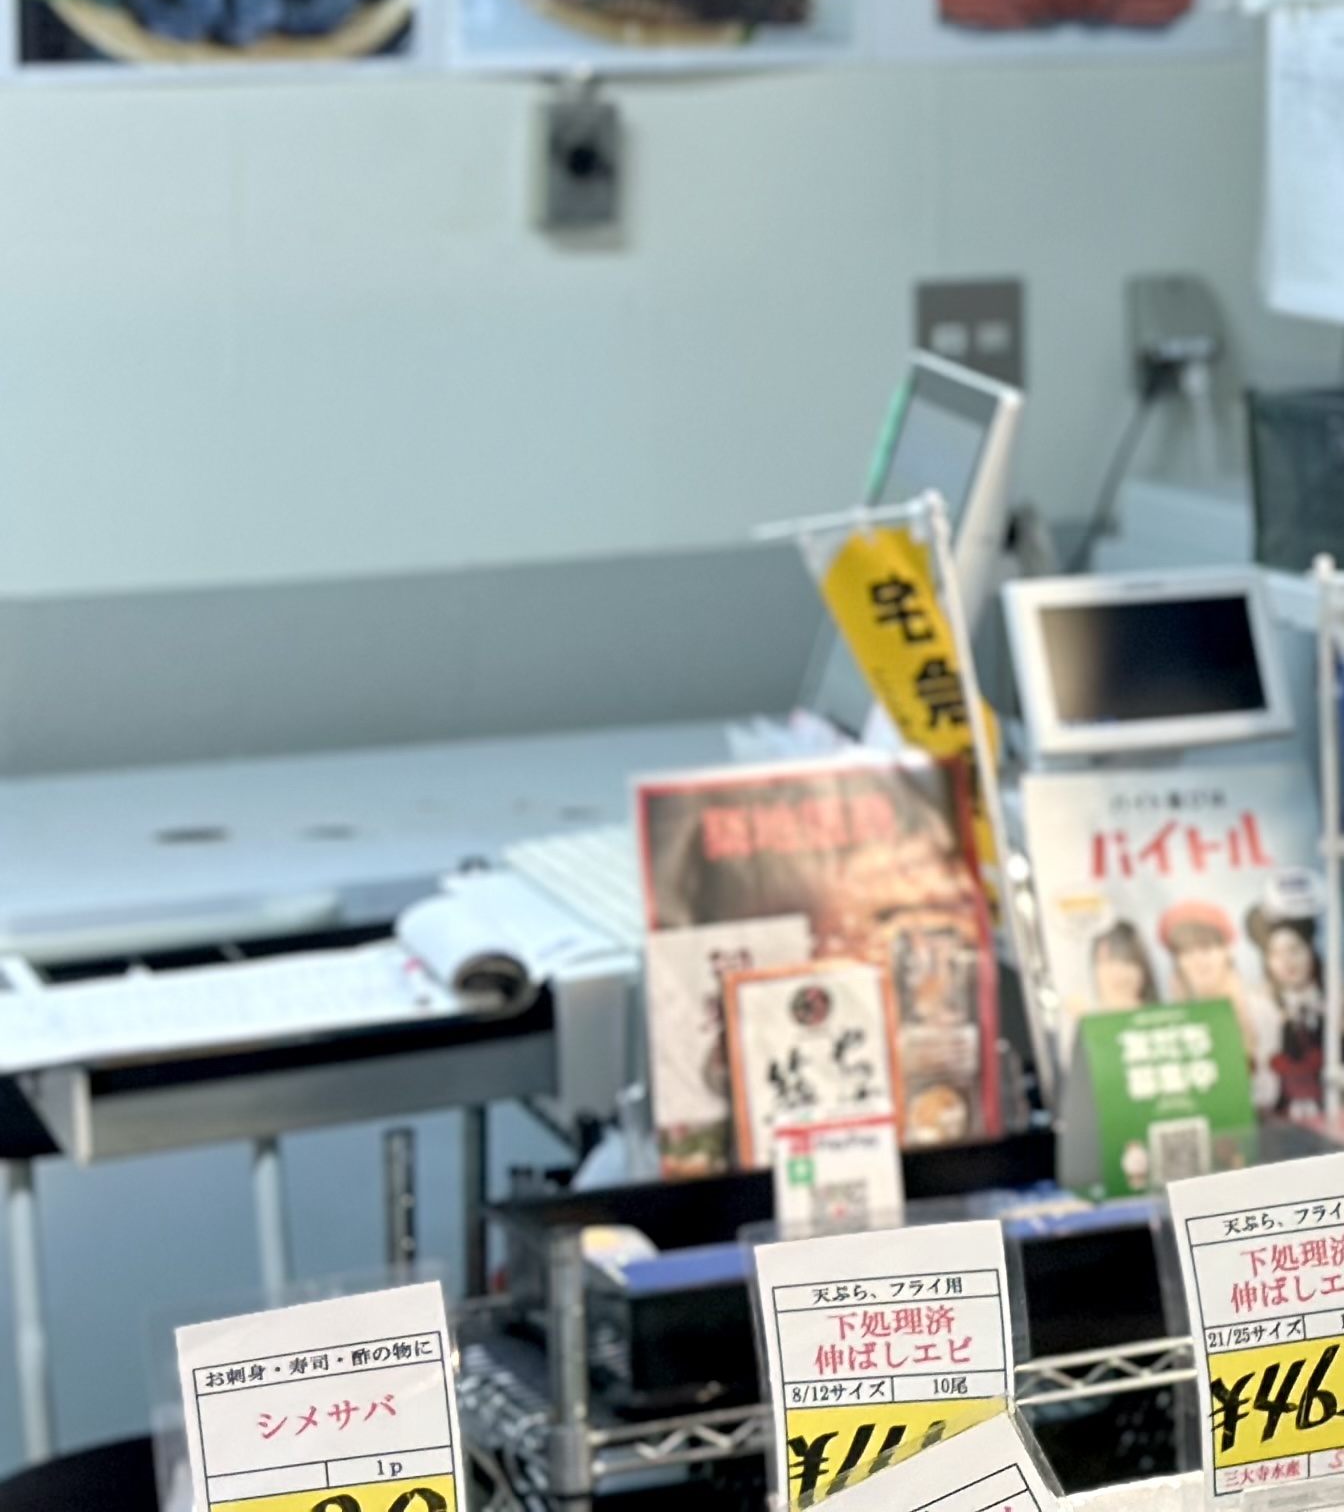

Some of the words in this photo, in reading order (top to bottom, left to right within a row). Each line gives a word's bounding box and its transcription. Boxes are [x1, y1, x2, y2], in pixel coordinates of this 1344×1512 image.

[1089, 807, 1275, 881] バイトル
[827, 1304, 955, 1340] 下処理済
[1207, 1318, 1302, 1349] 21/25サイズ
[814, 1336, 973, 1376] 伸ばしエビ
[791, 1380, 886, 1404] 8/12サイズ
[932, 1376, 969, 1395] 10尾
[256, 1393, 397, 1440] シメサバ
